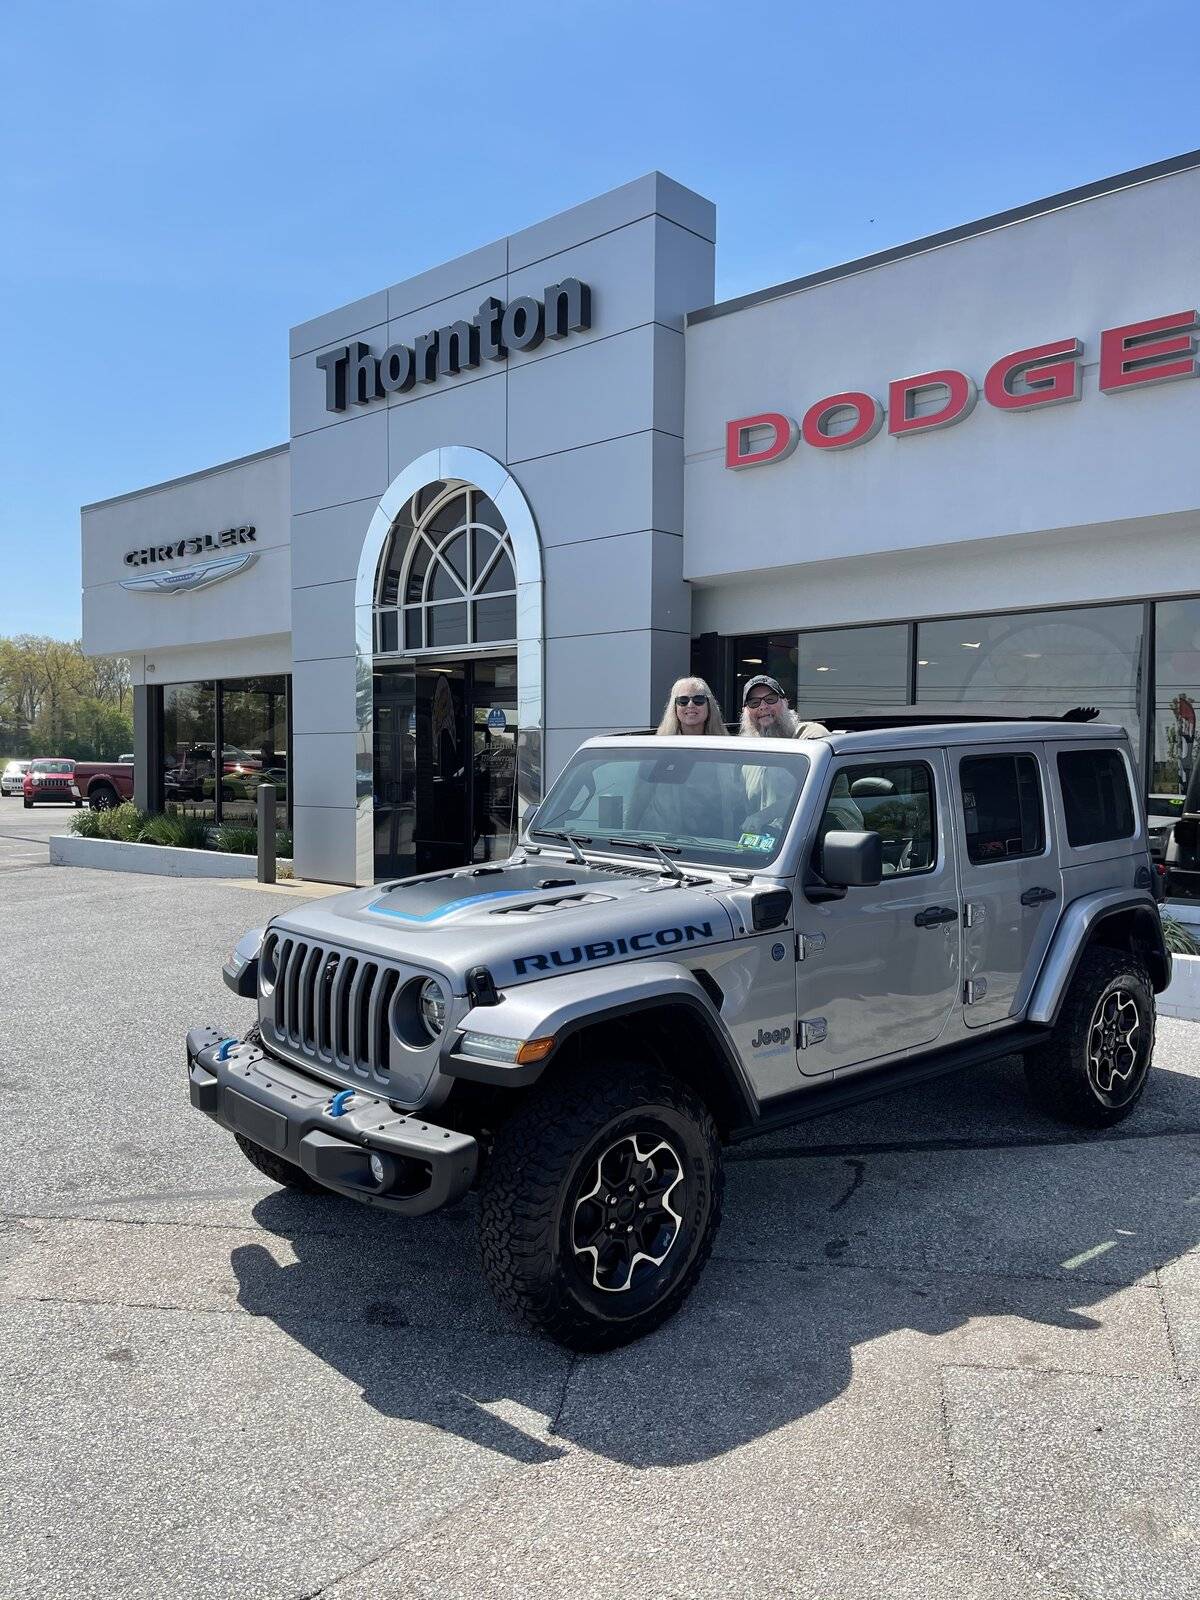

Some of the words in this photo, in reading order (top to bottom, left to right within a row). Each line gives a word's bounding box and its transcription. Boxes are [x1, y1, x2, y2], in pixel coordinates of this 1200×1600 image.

[316, 276, 592, 413] Thornton
[725, 309, 1200, 472] DODGE
[123, 525, 257, 567] CHRYSLER
[513, 922, 713, 976] RUBICON
[751, 1027, 791, 1048] Jeep
